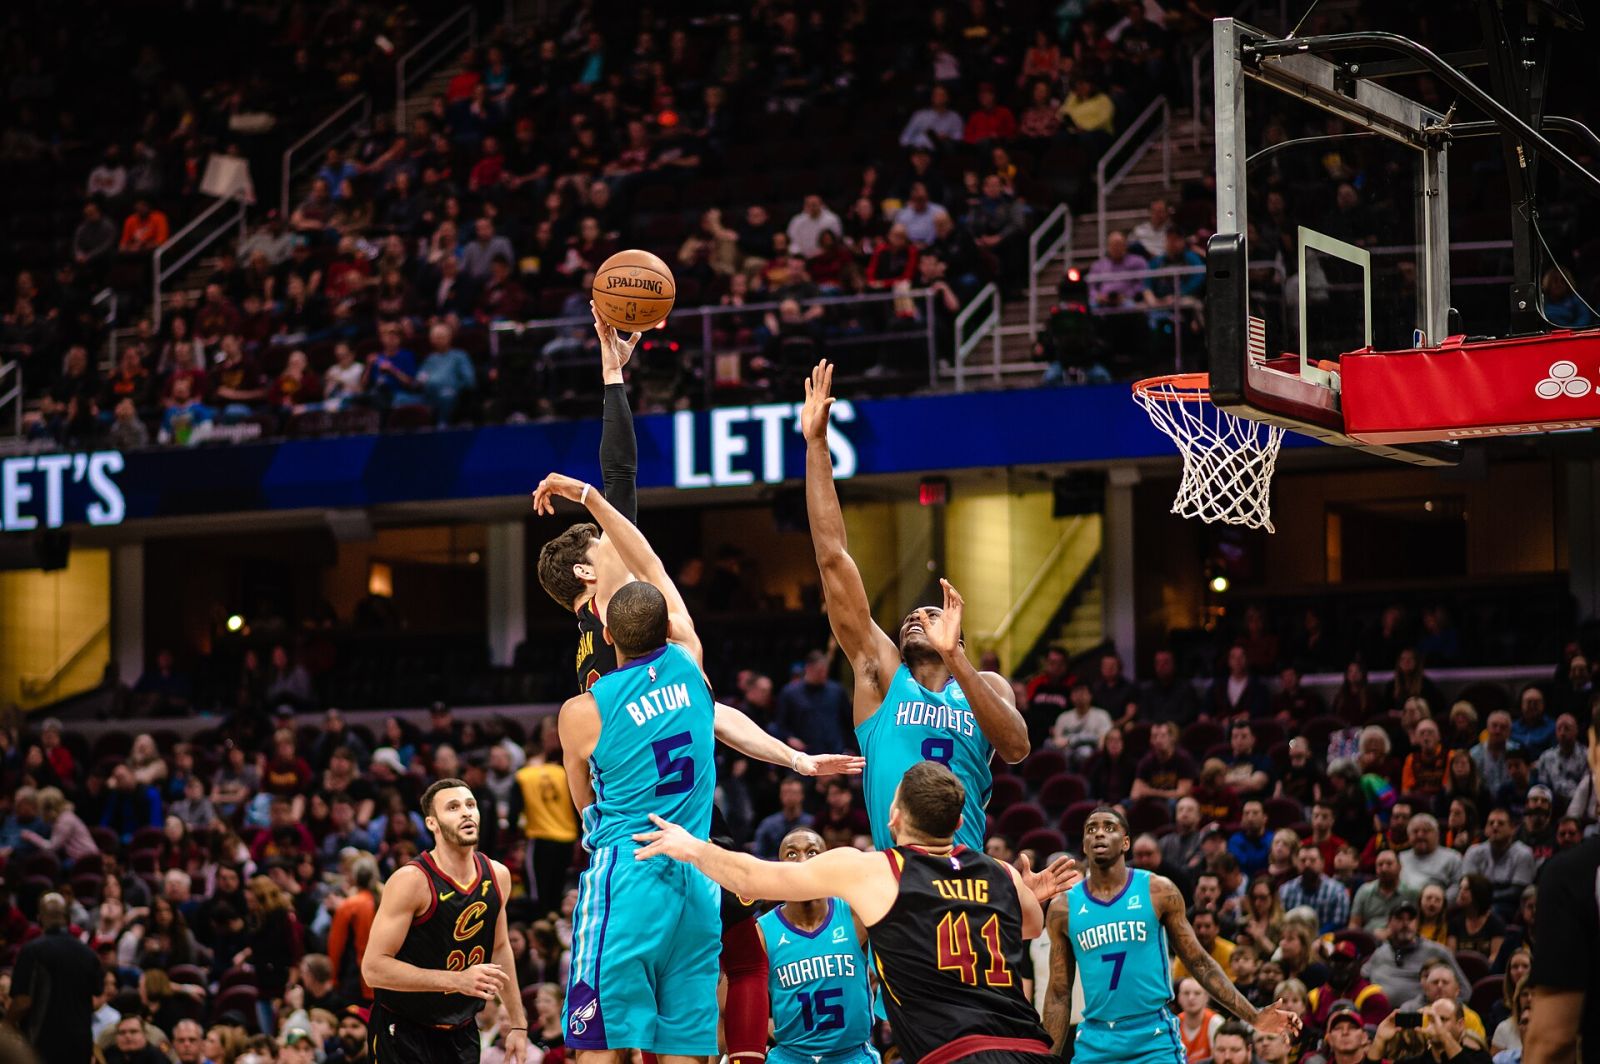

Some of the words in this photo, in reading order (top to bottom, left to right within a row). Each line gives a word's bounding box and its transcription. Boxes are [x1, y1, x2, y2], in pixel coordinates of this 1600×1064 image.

[606, 276, 663, 295] SPALDING
[0, 451, 125, 531] ET'S
[625, 683, 691, 727] BATUM
[896, 701, 975, 737] HORNETS
[651, 730, 695, 797] 5
[930, 879, 988, 903] ZIZIC
[937, 910, 1012, 986] 41
[1077, 920, 1147, 951] HORNETS
[777, 954, 855, 988] HORNETS
[1101, 951, 1127, 991] 7
[797, 988, 845, 1032] 15
